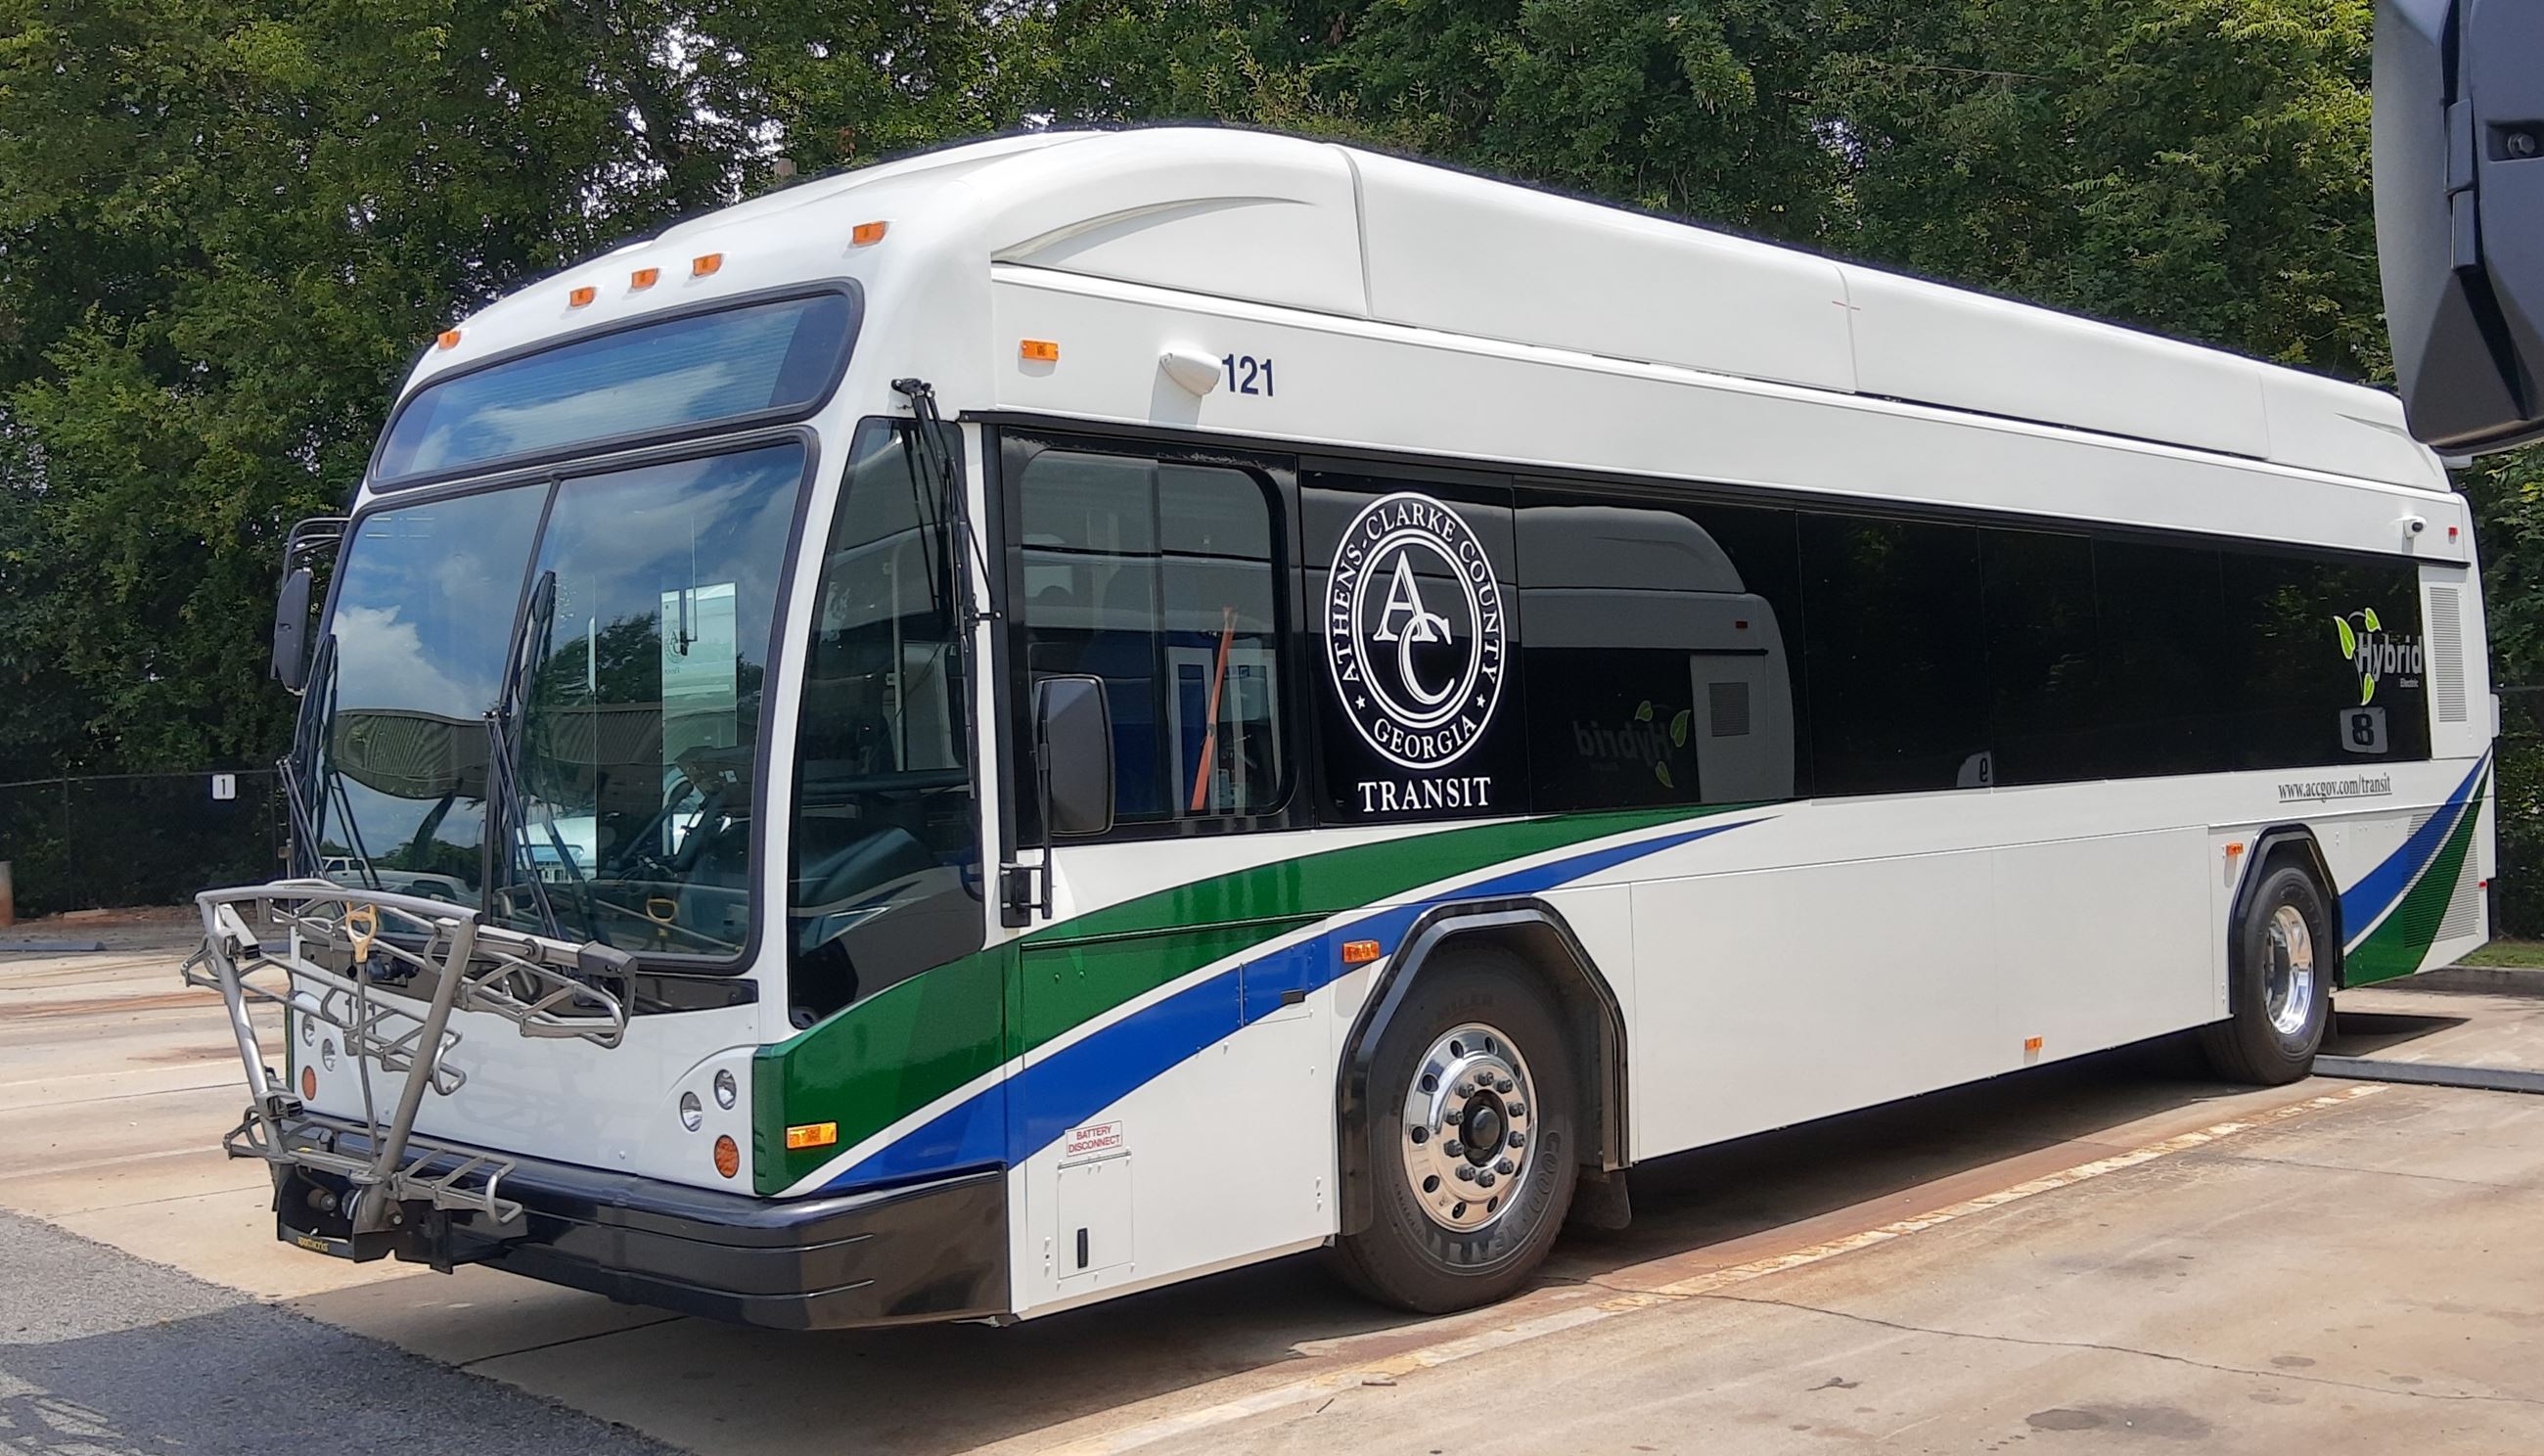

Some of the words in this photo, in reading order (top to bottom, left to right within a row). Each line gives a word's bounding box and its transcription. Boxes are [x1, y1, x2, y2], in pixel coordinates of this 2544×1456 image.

[1222, 353, 1274, 397] 121
[1459, 539, 1500, 684] COUNTY
[2358, 631, 2423, 682] Hybrid
[1373, 712, 1478, 760] GEORGIA
[1358, 776, 1491, 813] TRANSIT
[2279, 773, 2390, 801] www.accgov.com/transit
[1068, 1135, 1120, 1154] DISCONNECT
[1076, 1125, 1113, 1141] BATTERY
